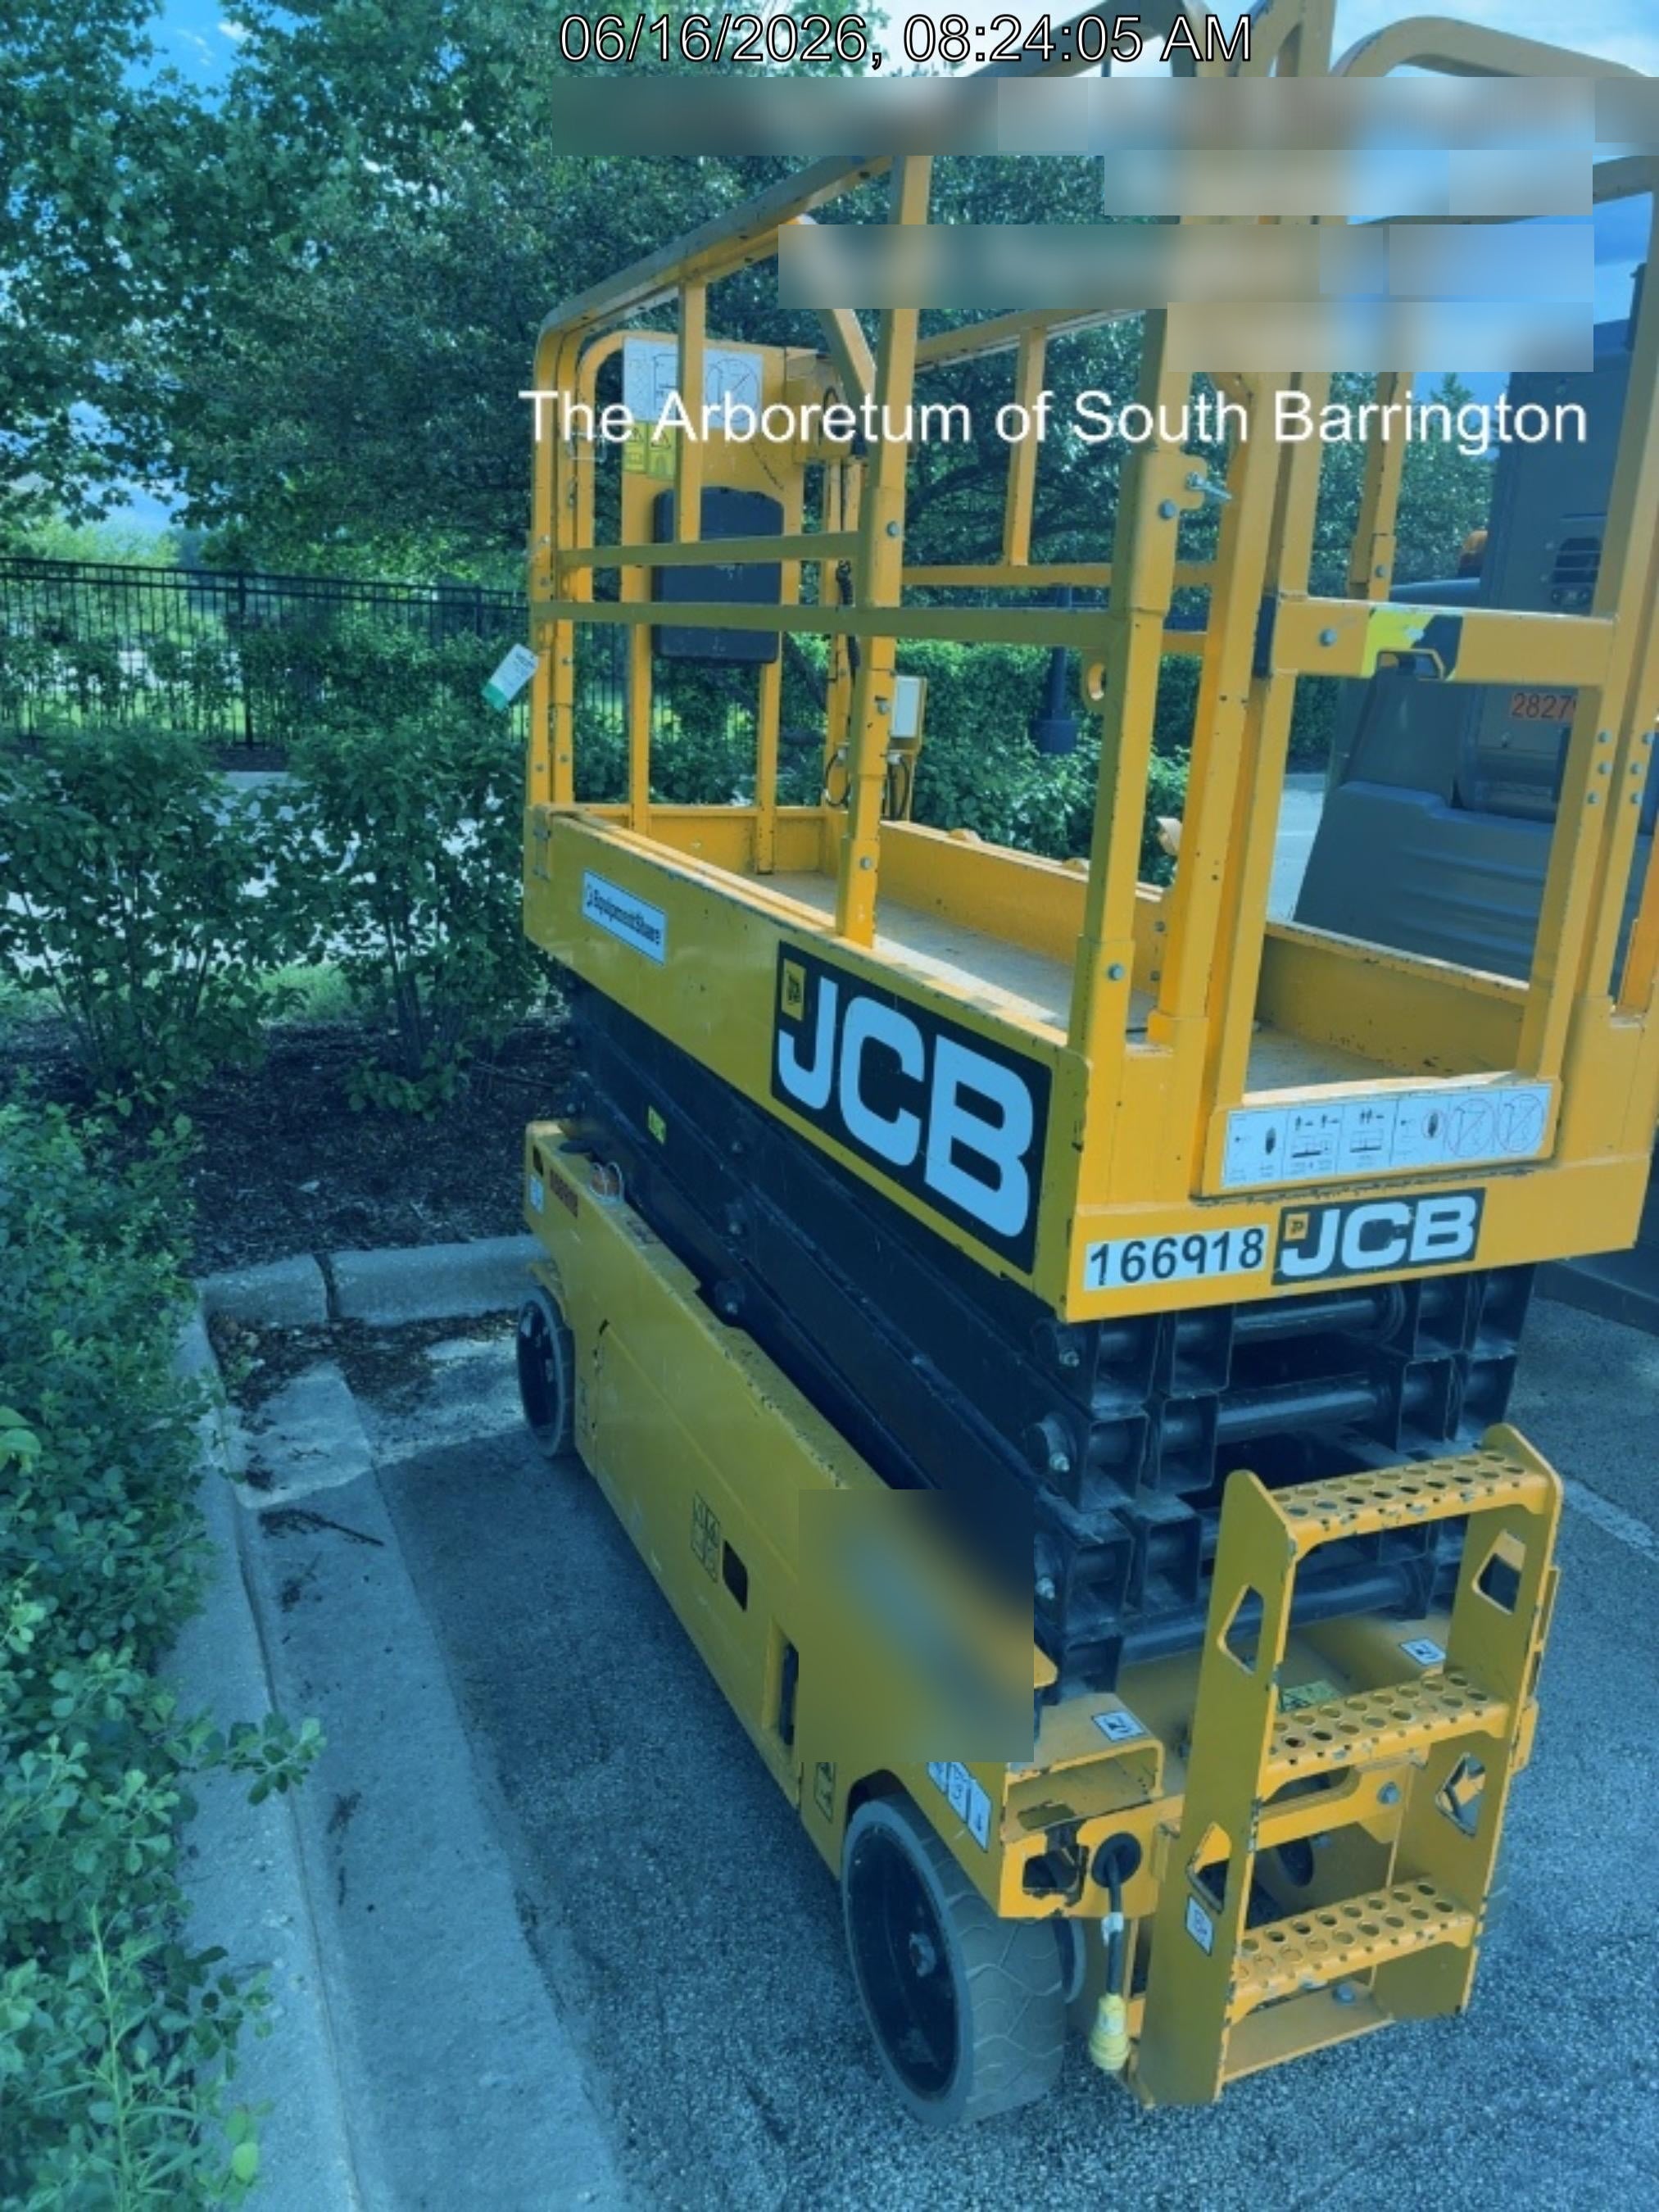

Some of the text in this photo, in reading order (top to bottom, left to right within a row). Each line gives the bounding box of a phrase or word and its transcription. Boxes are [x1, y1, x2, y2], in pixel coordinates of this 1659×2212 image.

[1511, 691, 1576, 719] 2827
[778, 977, 1034, 1238] JCB
[1090, 1227, 1263, 1286] 166918
[1281, 1195, 1477, 1276] JCB
